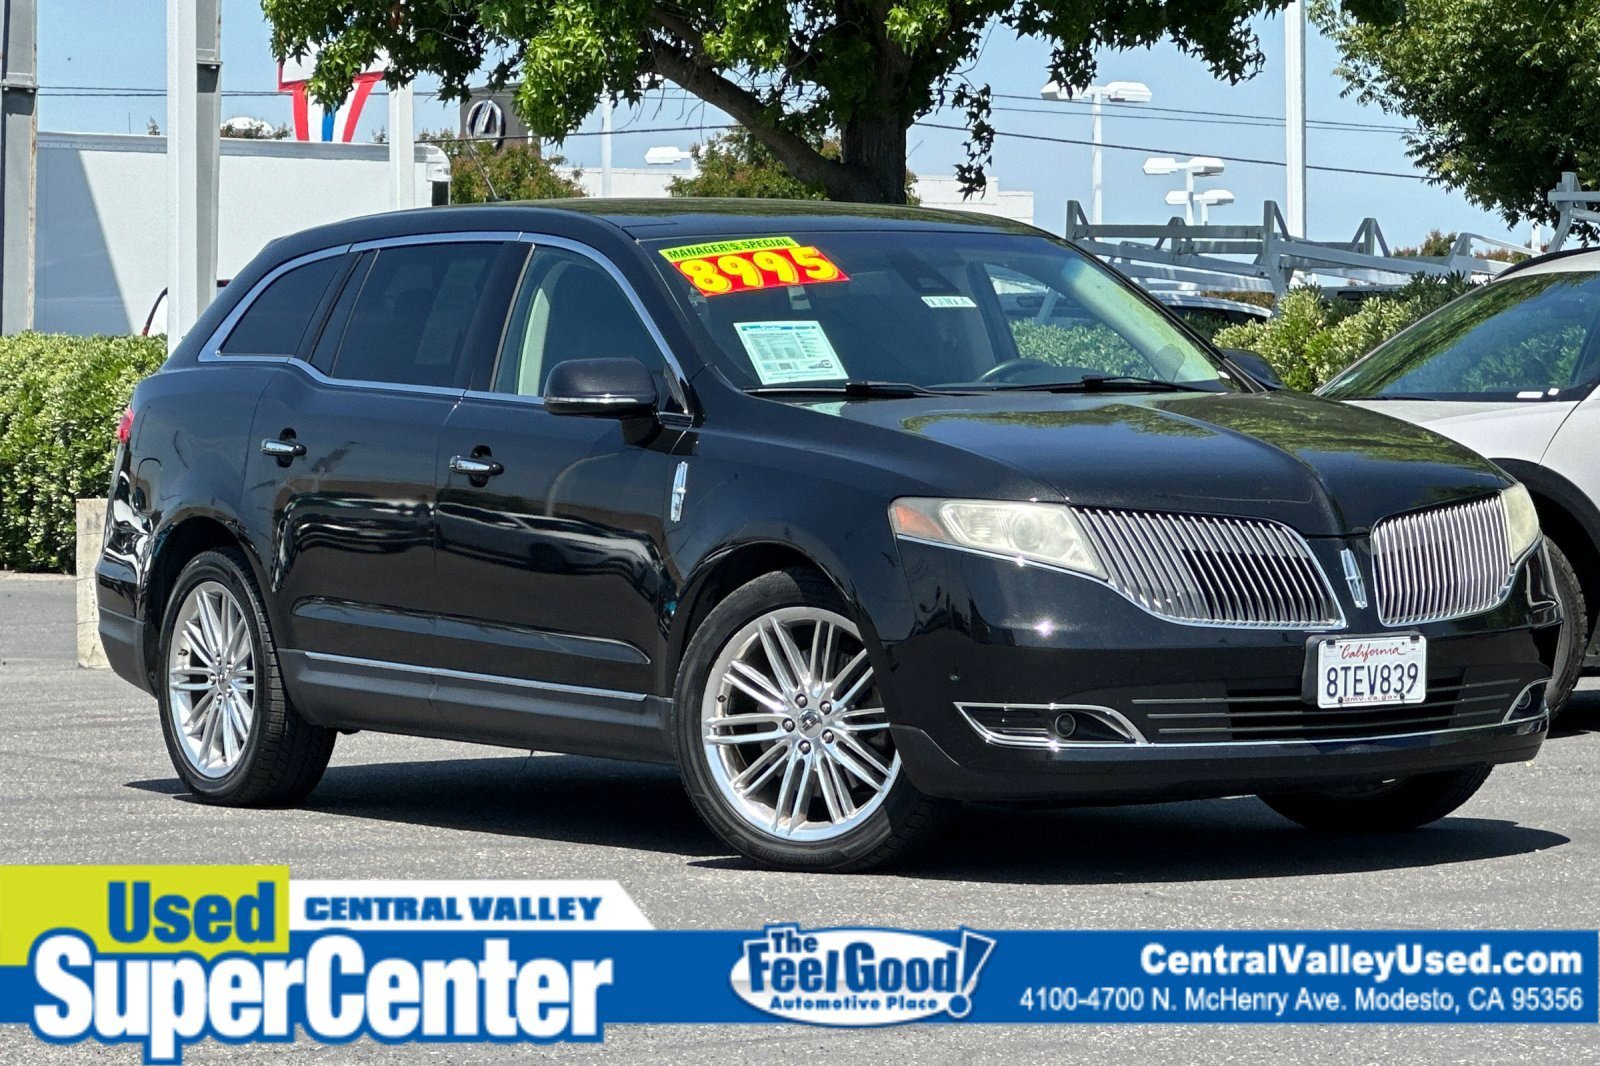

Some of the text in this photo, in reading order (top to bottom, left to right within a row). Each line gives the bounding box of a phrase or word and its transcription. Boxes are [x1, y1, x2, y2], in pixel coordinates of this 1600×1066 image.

[667, 238, 792, 260] MANAGER'S SPECIAL
[679, 246, 839, 294] 8995
[1341, 643, 1406, 663] California
[1326, 662, 1419, 698] 8TEV839
